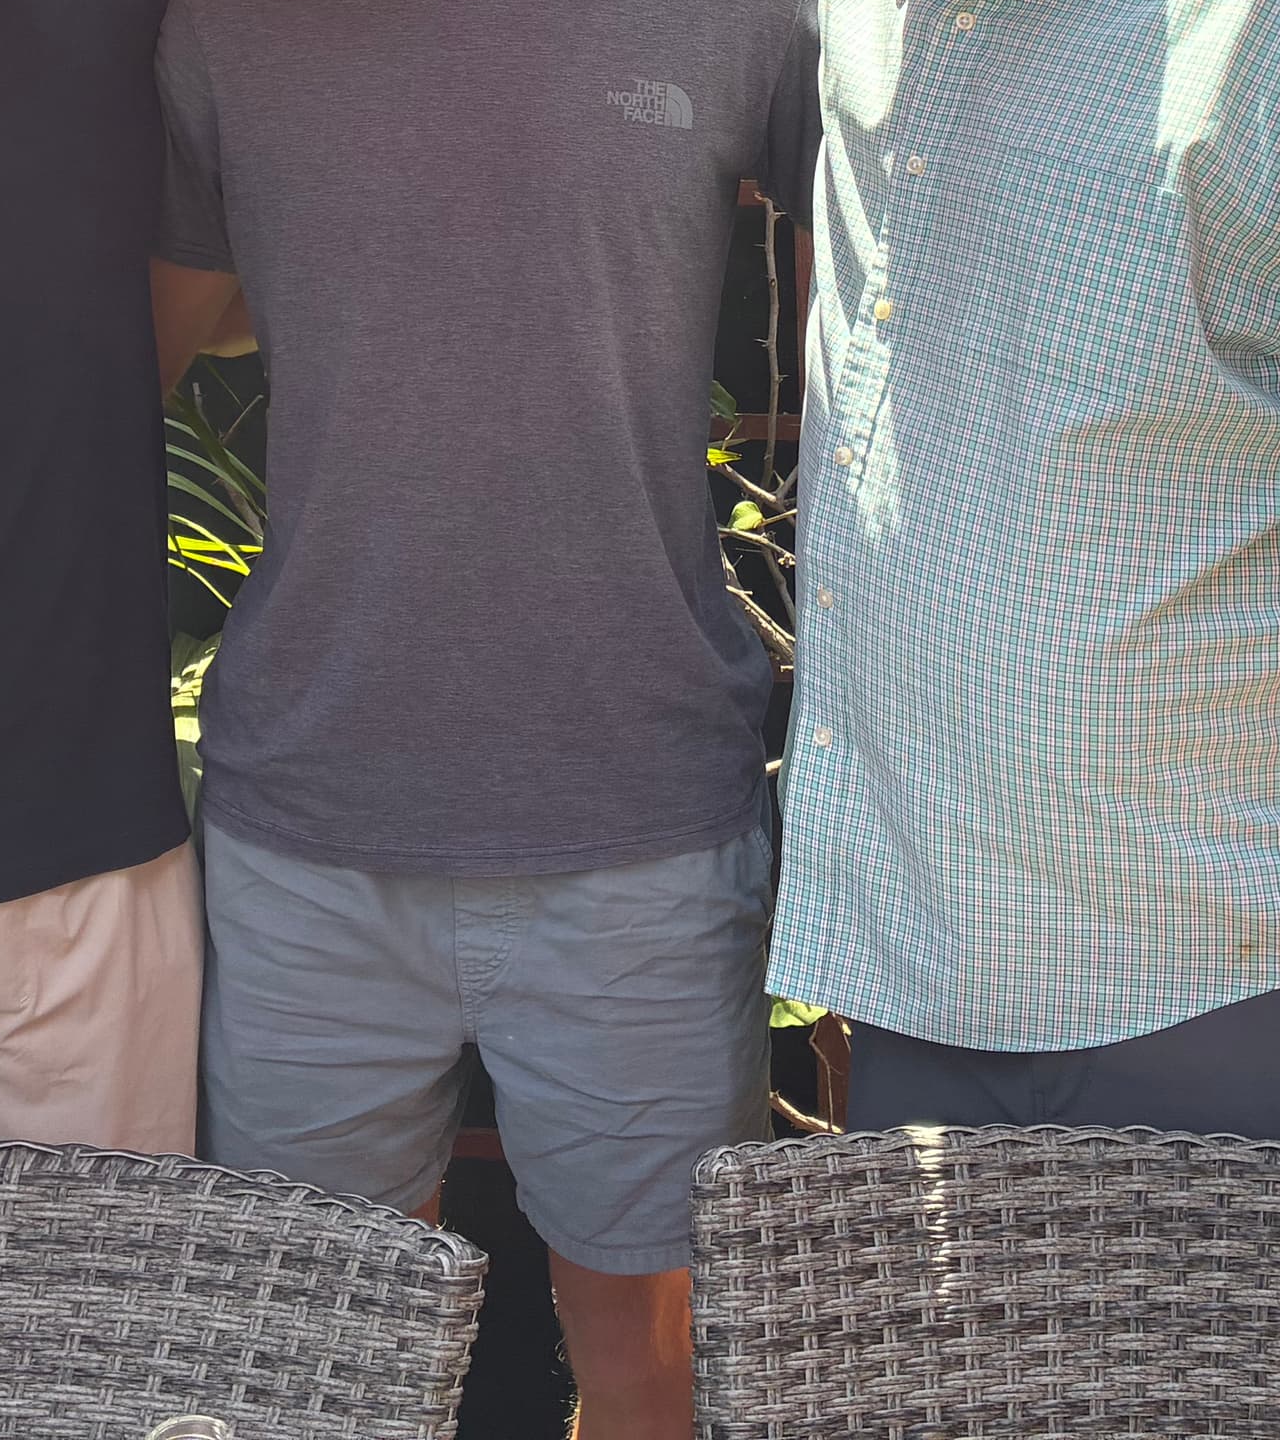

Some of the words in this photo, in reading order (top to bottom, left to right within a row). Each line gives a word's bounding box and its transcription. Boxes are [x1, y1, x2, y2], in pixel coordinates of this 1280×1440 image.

[636, 79, 666, 96] THE
[607, 91, 665, 111] NORTH
[624, 107, 665, 125] FACE
